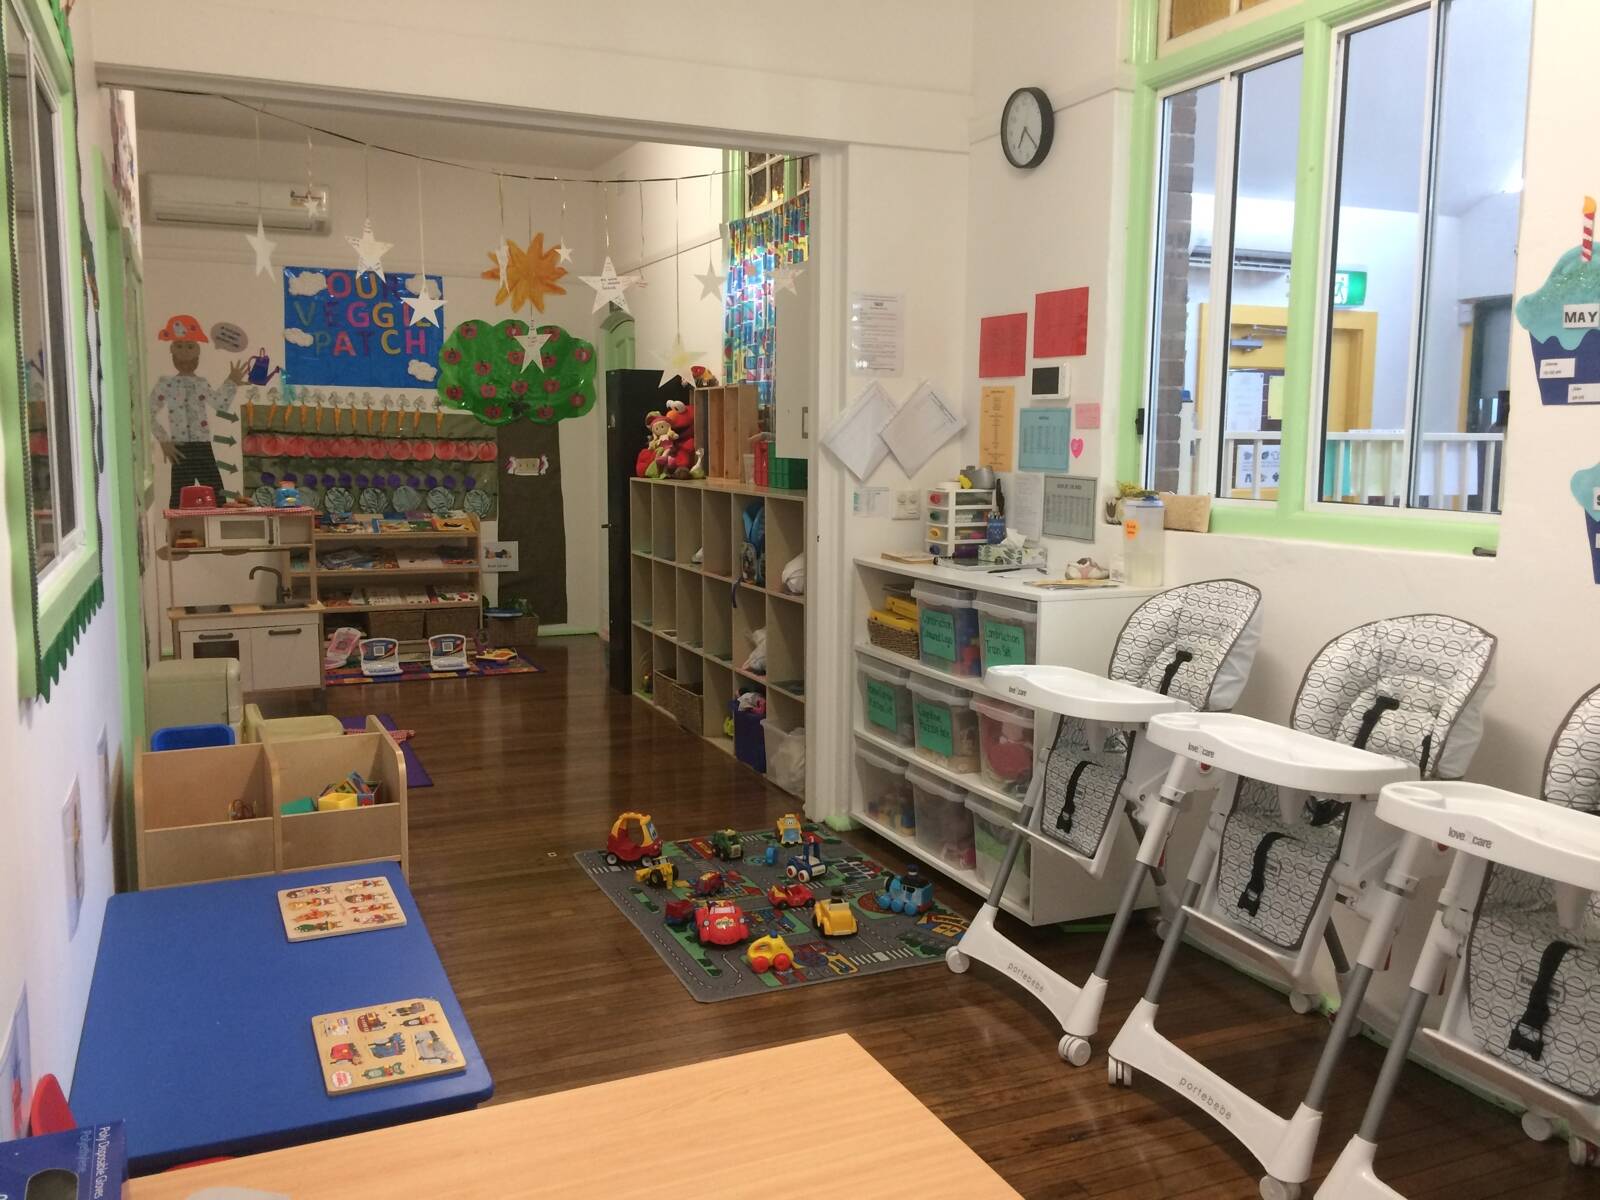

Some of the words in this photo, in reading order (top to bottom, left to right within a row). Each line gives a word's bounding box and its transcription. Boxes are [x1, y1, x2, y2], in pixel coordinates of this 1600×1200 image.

[326, 271, 400, 301] OUR
[293, 301, 432, 328] VEGGI
[1564, 311, 1598, 323] MAY
[314, 329, 427, 357] PATCH
[1188, 741, 1199, 753] love
[1202, 748, 1215, 759] care
[1448, 826, 1466, 841] love
[1472, 836, 1492, 849] care
[1007, 962, 1044, 993] portebebe
[1179, 1076, 1233, 1121] portebebe
[96, 1126, 111, 1141] Poly
[95, 1141, 110, 1176] Disposable
